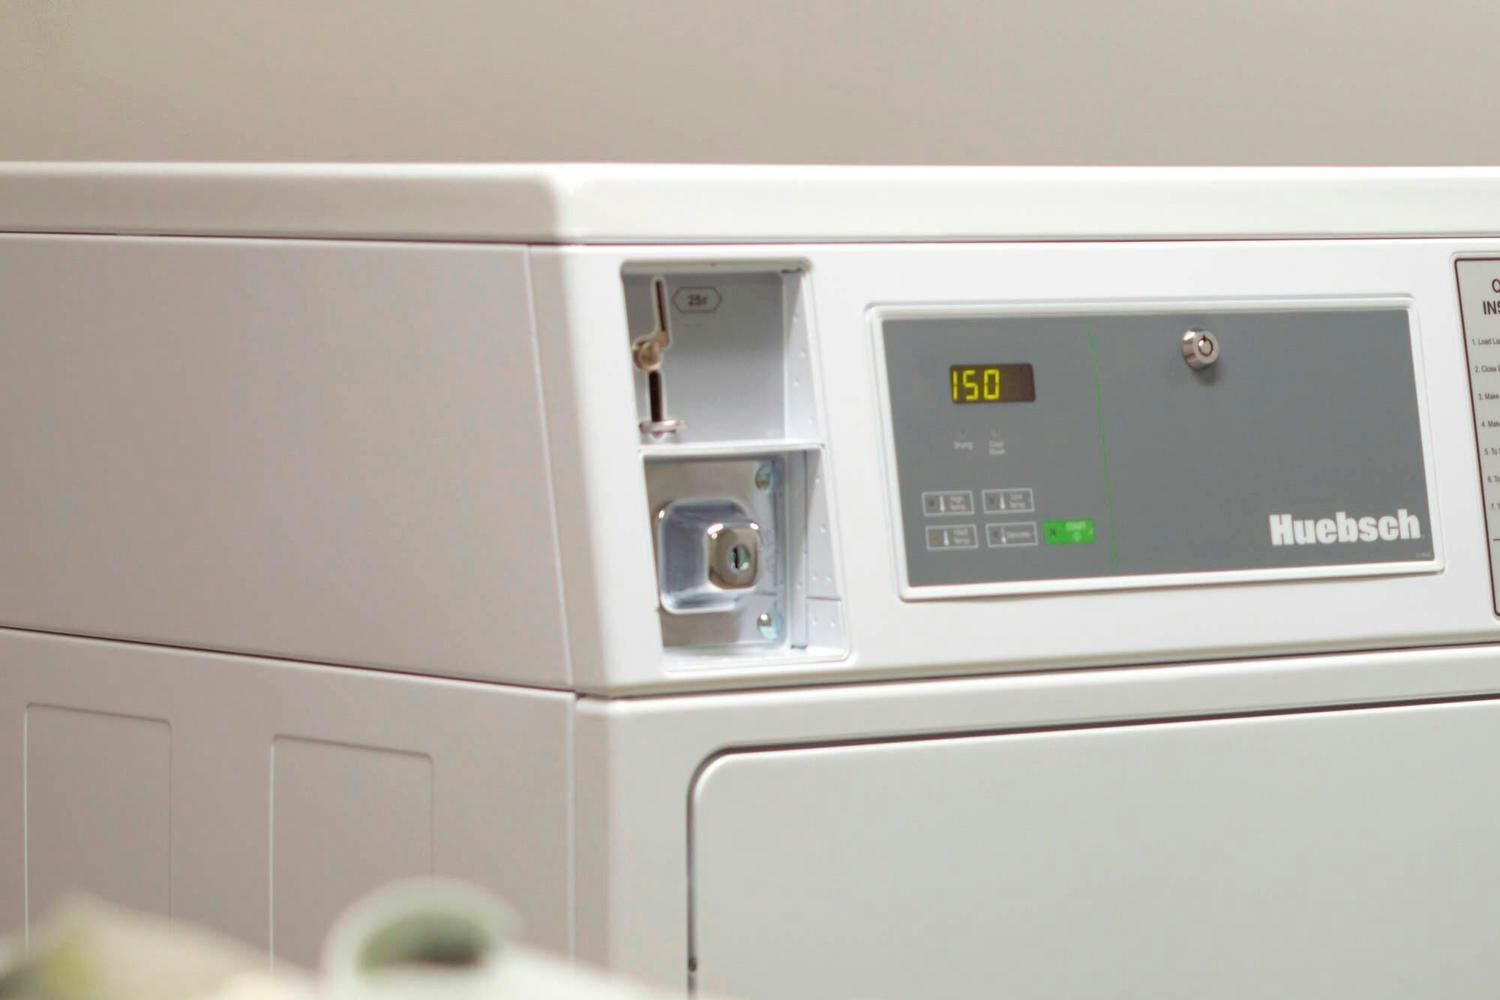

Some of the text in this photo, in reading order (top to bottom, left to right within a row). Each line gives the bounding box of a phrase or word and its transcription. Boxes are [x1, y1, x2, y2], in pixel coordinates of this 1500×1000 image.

[1481, 365, 1497, 373] Close
[953, 369, 1000, 401] 150
[1485, 392, 1499, 400] Make
[1269, 508, 1421, 546] Huebsch
